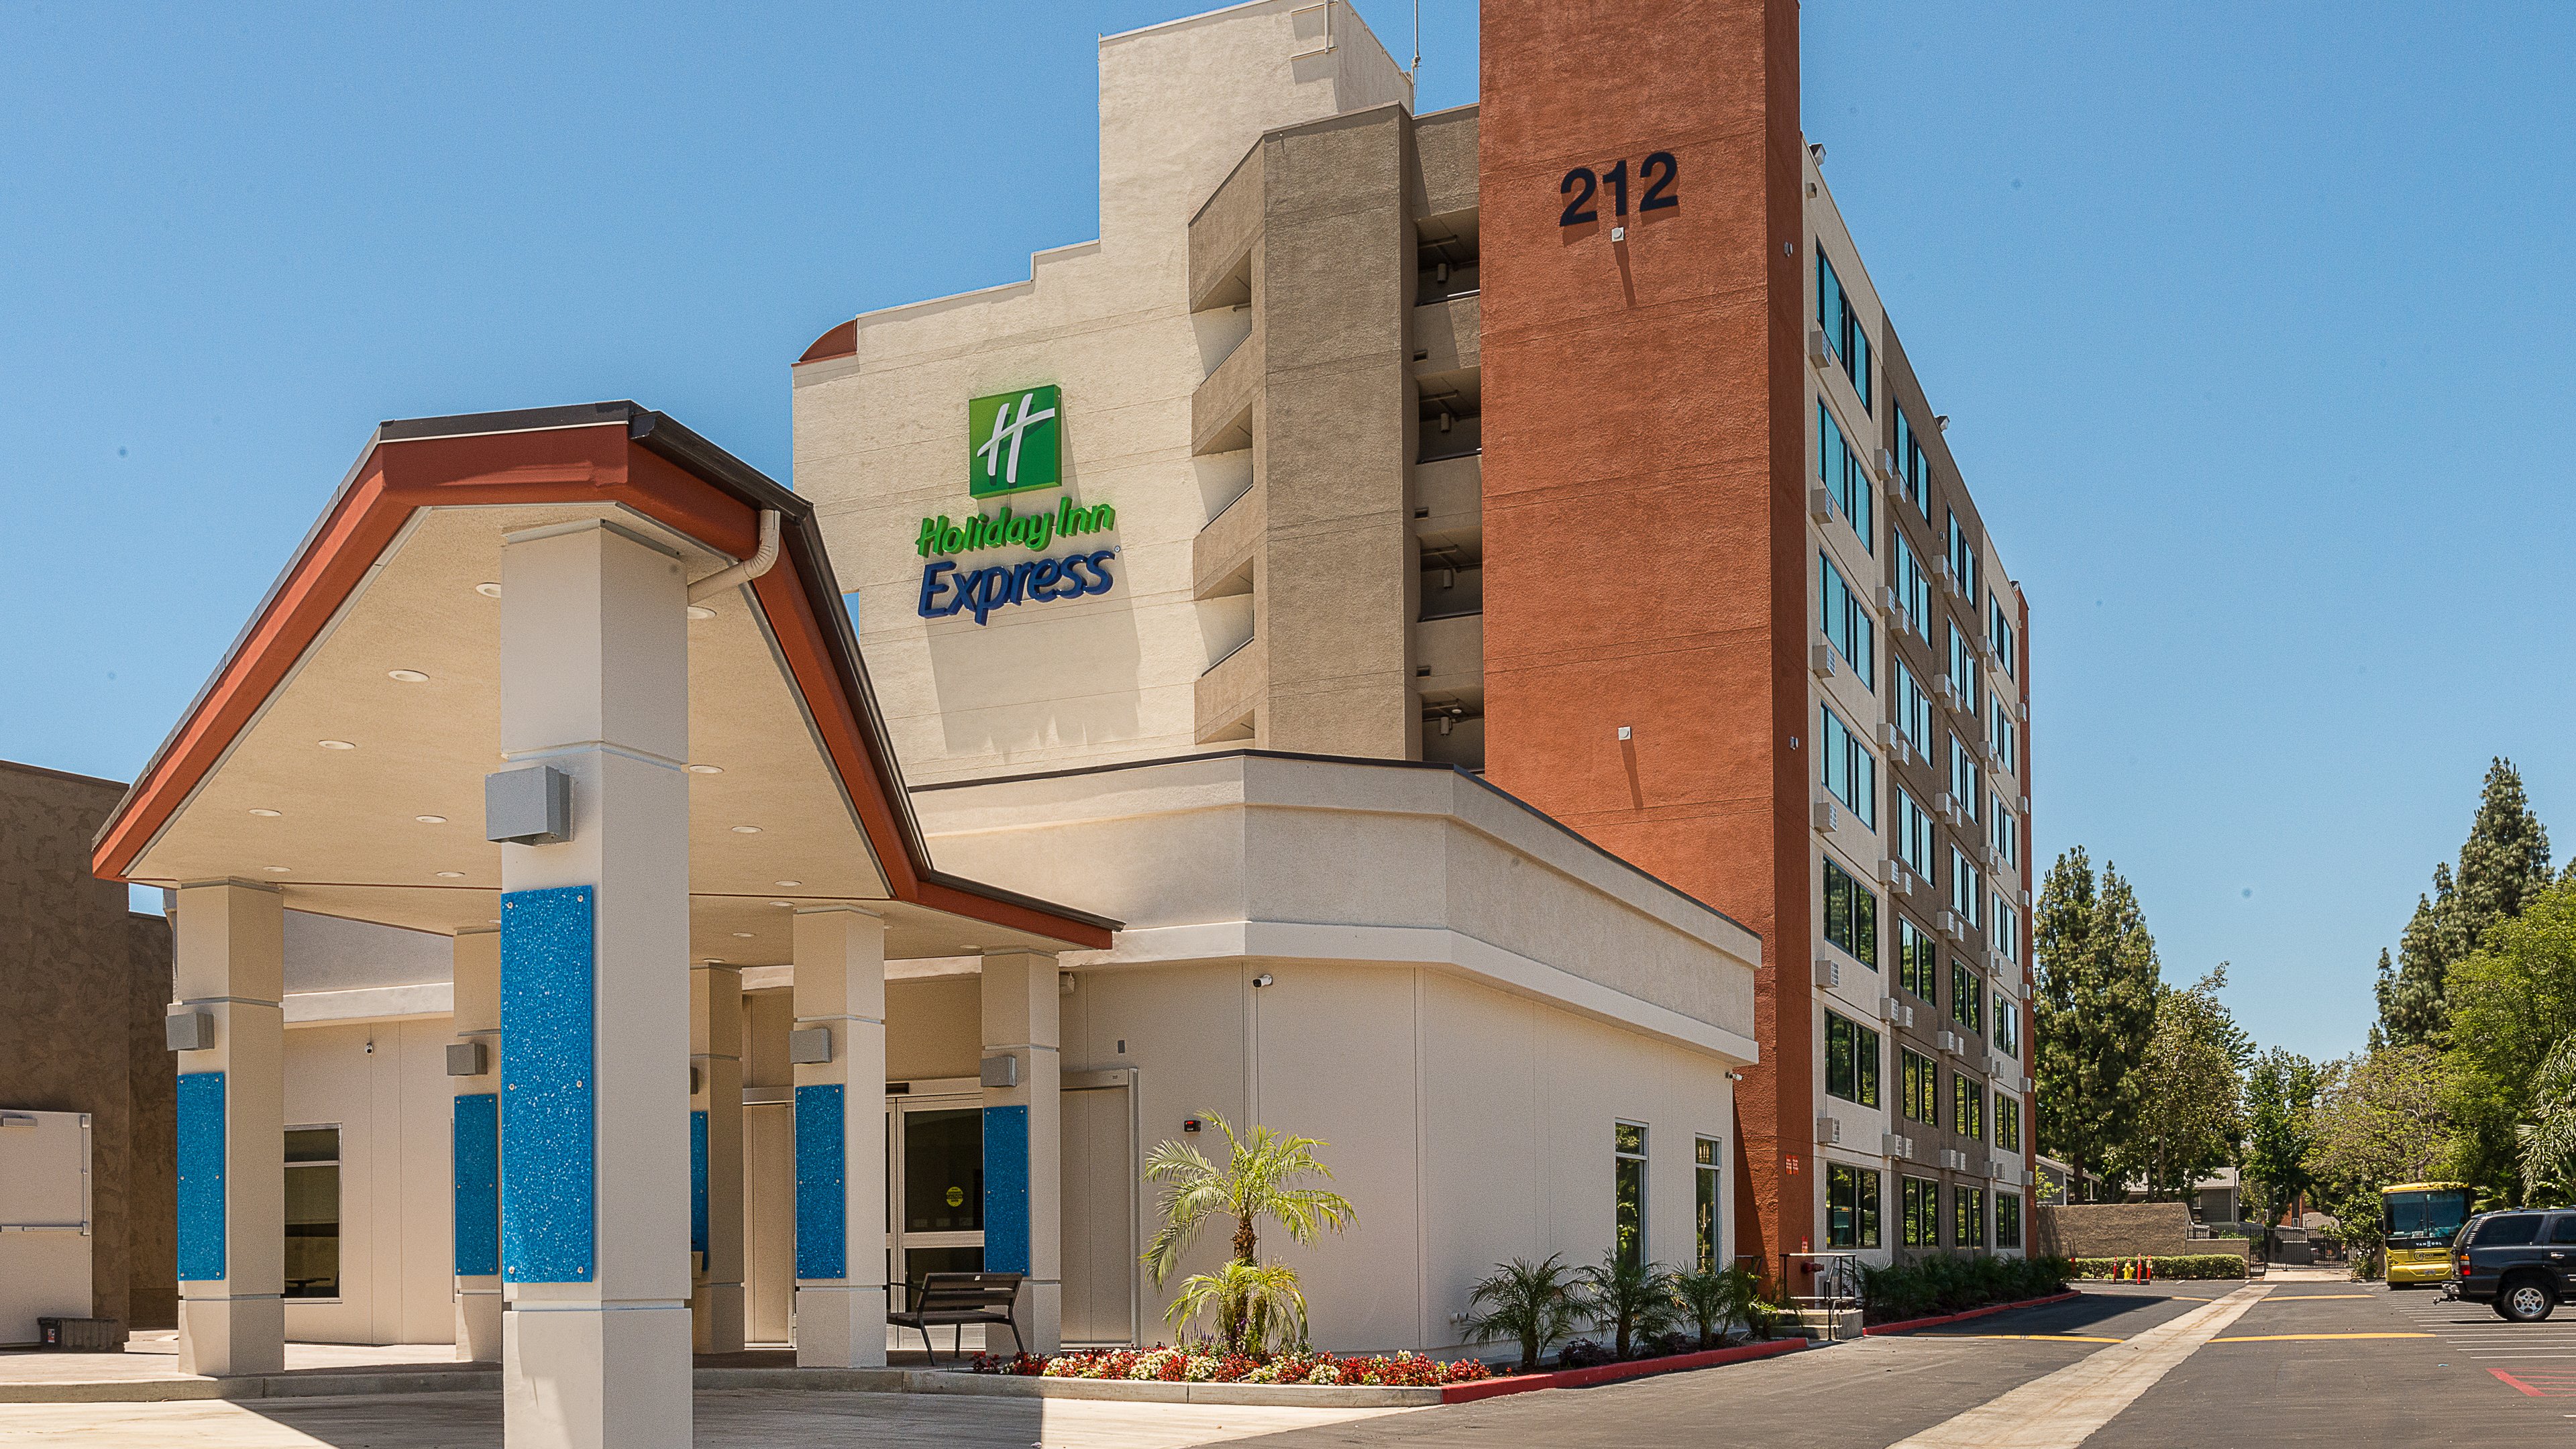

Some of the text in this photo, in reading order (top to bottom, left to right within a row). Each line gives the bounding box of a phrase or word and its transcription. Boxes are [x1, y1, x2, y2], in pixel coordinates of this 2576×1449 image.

[1559, 152, 1678, 227] 212
[915, 496, 1116, 558] Holiday Inn
[918, 550, 1116, 626] Express
